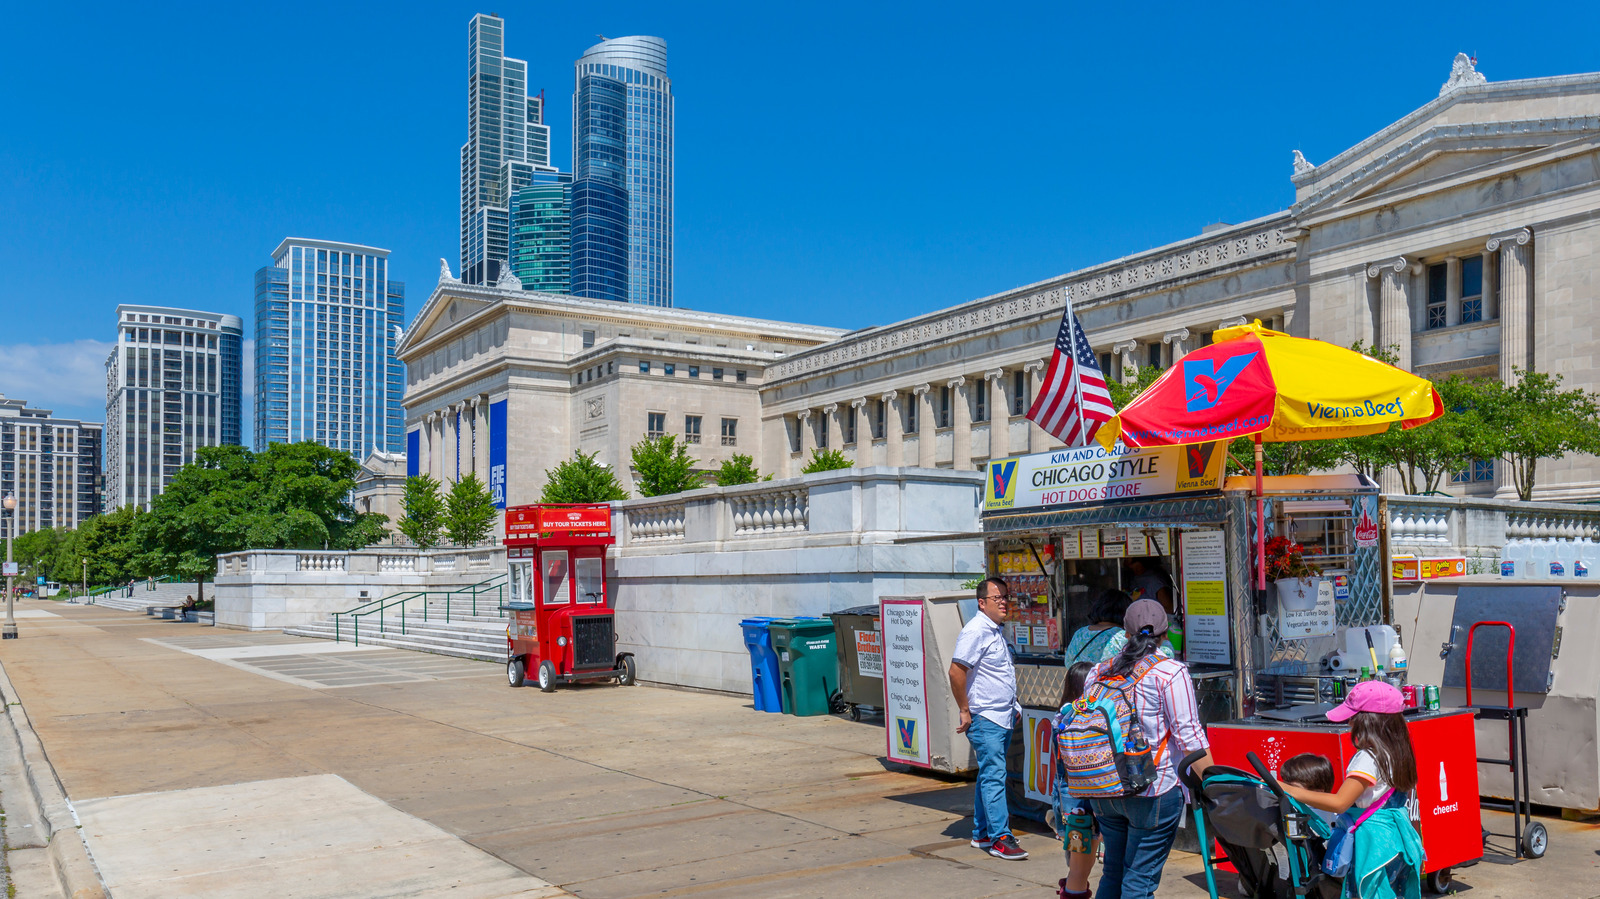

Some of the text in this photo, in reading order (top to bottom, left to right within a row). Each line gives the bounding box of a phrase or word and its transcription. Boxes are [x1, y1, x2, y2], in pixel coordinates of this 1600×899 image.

[1127, 414, 1270, 440] www.viennabeef.com
[1050, 445, 1140, 464] KIM AND CRLOS
[1031, 456, 1160, 487] CHICAGO STYLE
[1178, 478, 1217, 489] Vienna Beef
[1041, 482, 1142, 505] HOT DOG STORE
[887, 609, 918, 618] Chicago Style
[900, 618, 913, 627] Dogs
[1287, 620, 1309, 628] Vegetarian
[859, 632, 876, 643] Flood
[857, 642, 881, 654] Brothers
[892, 643, 913, 652] Sausages
[889, 660, 918, 670] Veggie Dogs
[891, 676, 919, 687] Turkey Dogs
[891, 693, 921, 704] Chips, Candy,
[1433, 802, 1458, 815] cheers!
